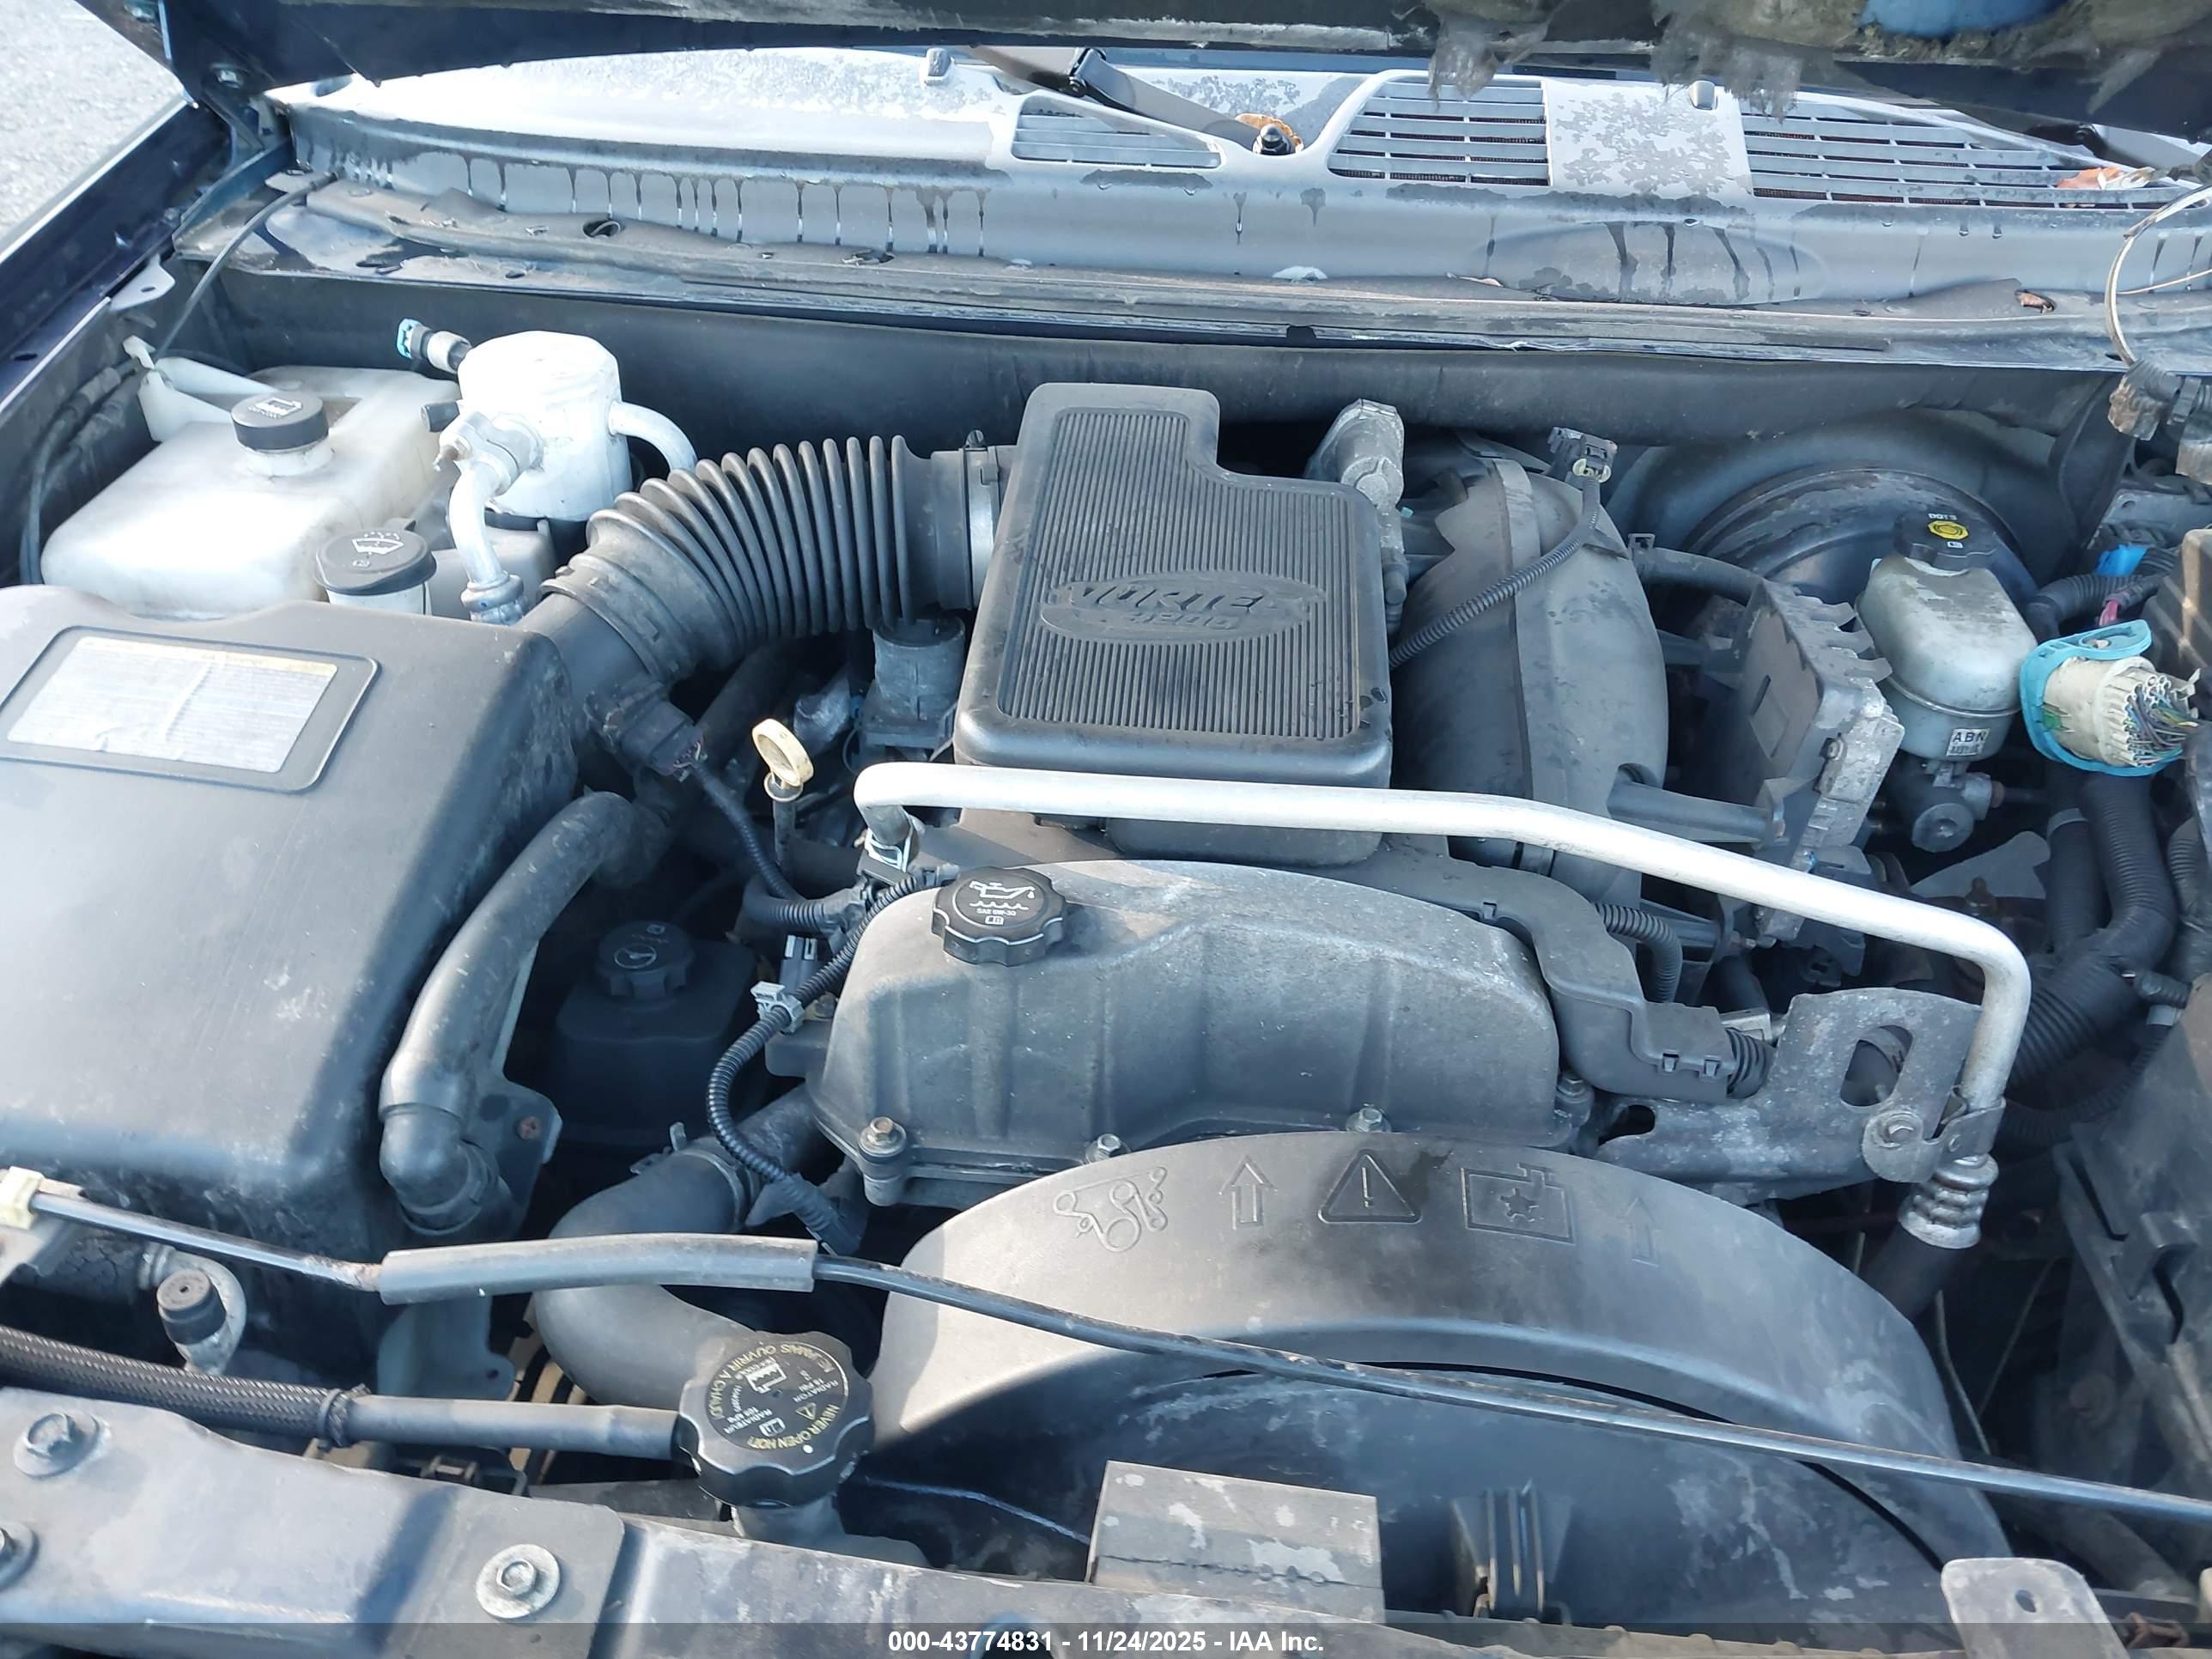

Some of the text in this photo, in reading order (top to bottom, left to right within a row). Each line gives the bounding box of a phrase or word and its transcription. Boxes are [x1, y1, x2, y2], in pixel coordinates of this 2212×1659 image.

[1952, 732, 1988, 743] ABN
[729, 1344, 776, 1372] OUVRIR
[793, 1380, 839, 1403] RADIATOR
[723, 1408, 772, 1435] RADIATEUR
[811, 1403, 841, 1436] NEVER
[777, 1430, 811, 1449] OPEN
